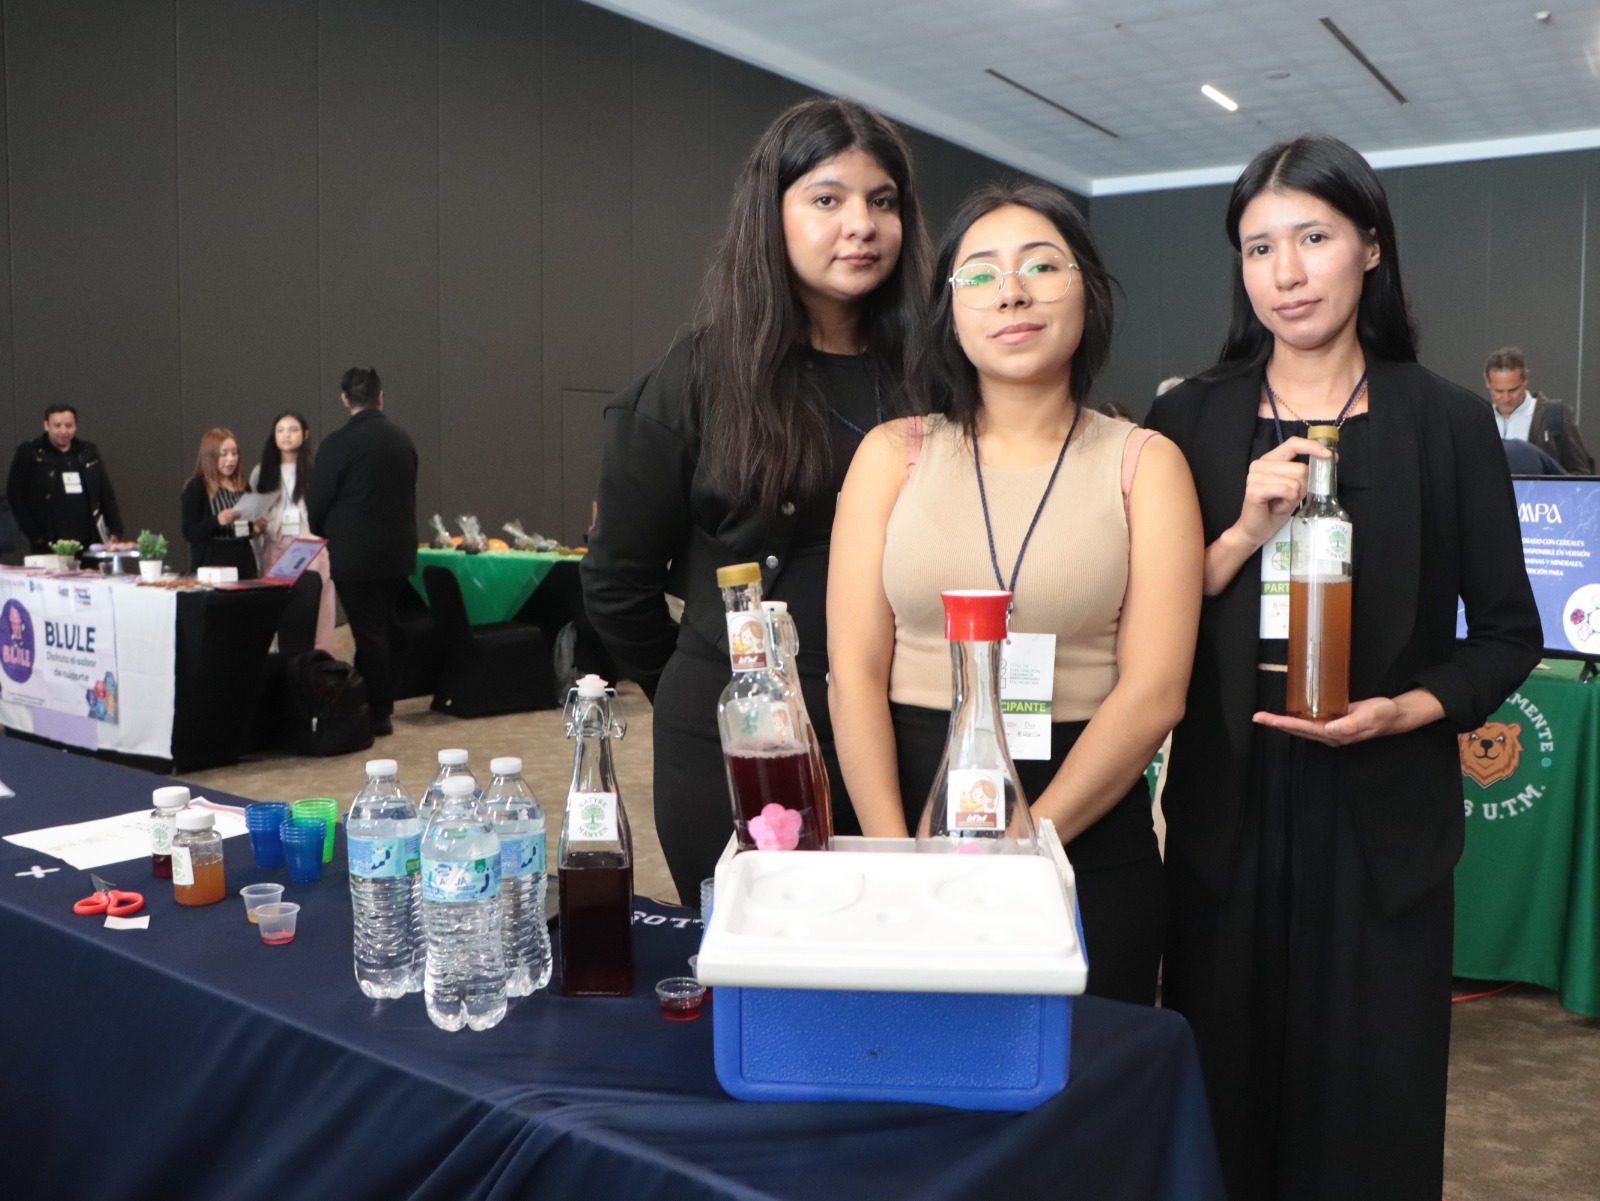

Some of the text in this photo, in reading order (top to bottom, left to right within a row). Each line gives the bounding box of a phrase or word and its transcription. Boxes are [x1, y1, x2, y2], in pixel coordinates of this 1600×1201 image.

[45, 621, 96, 653] BLULE
[1507, 693, 1554, 752] MENTE
[1482, 784, 1546, 820] U.T.M.
